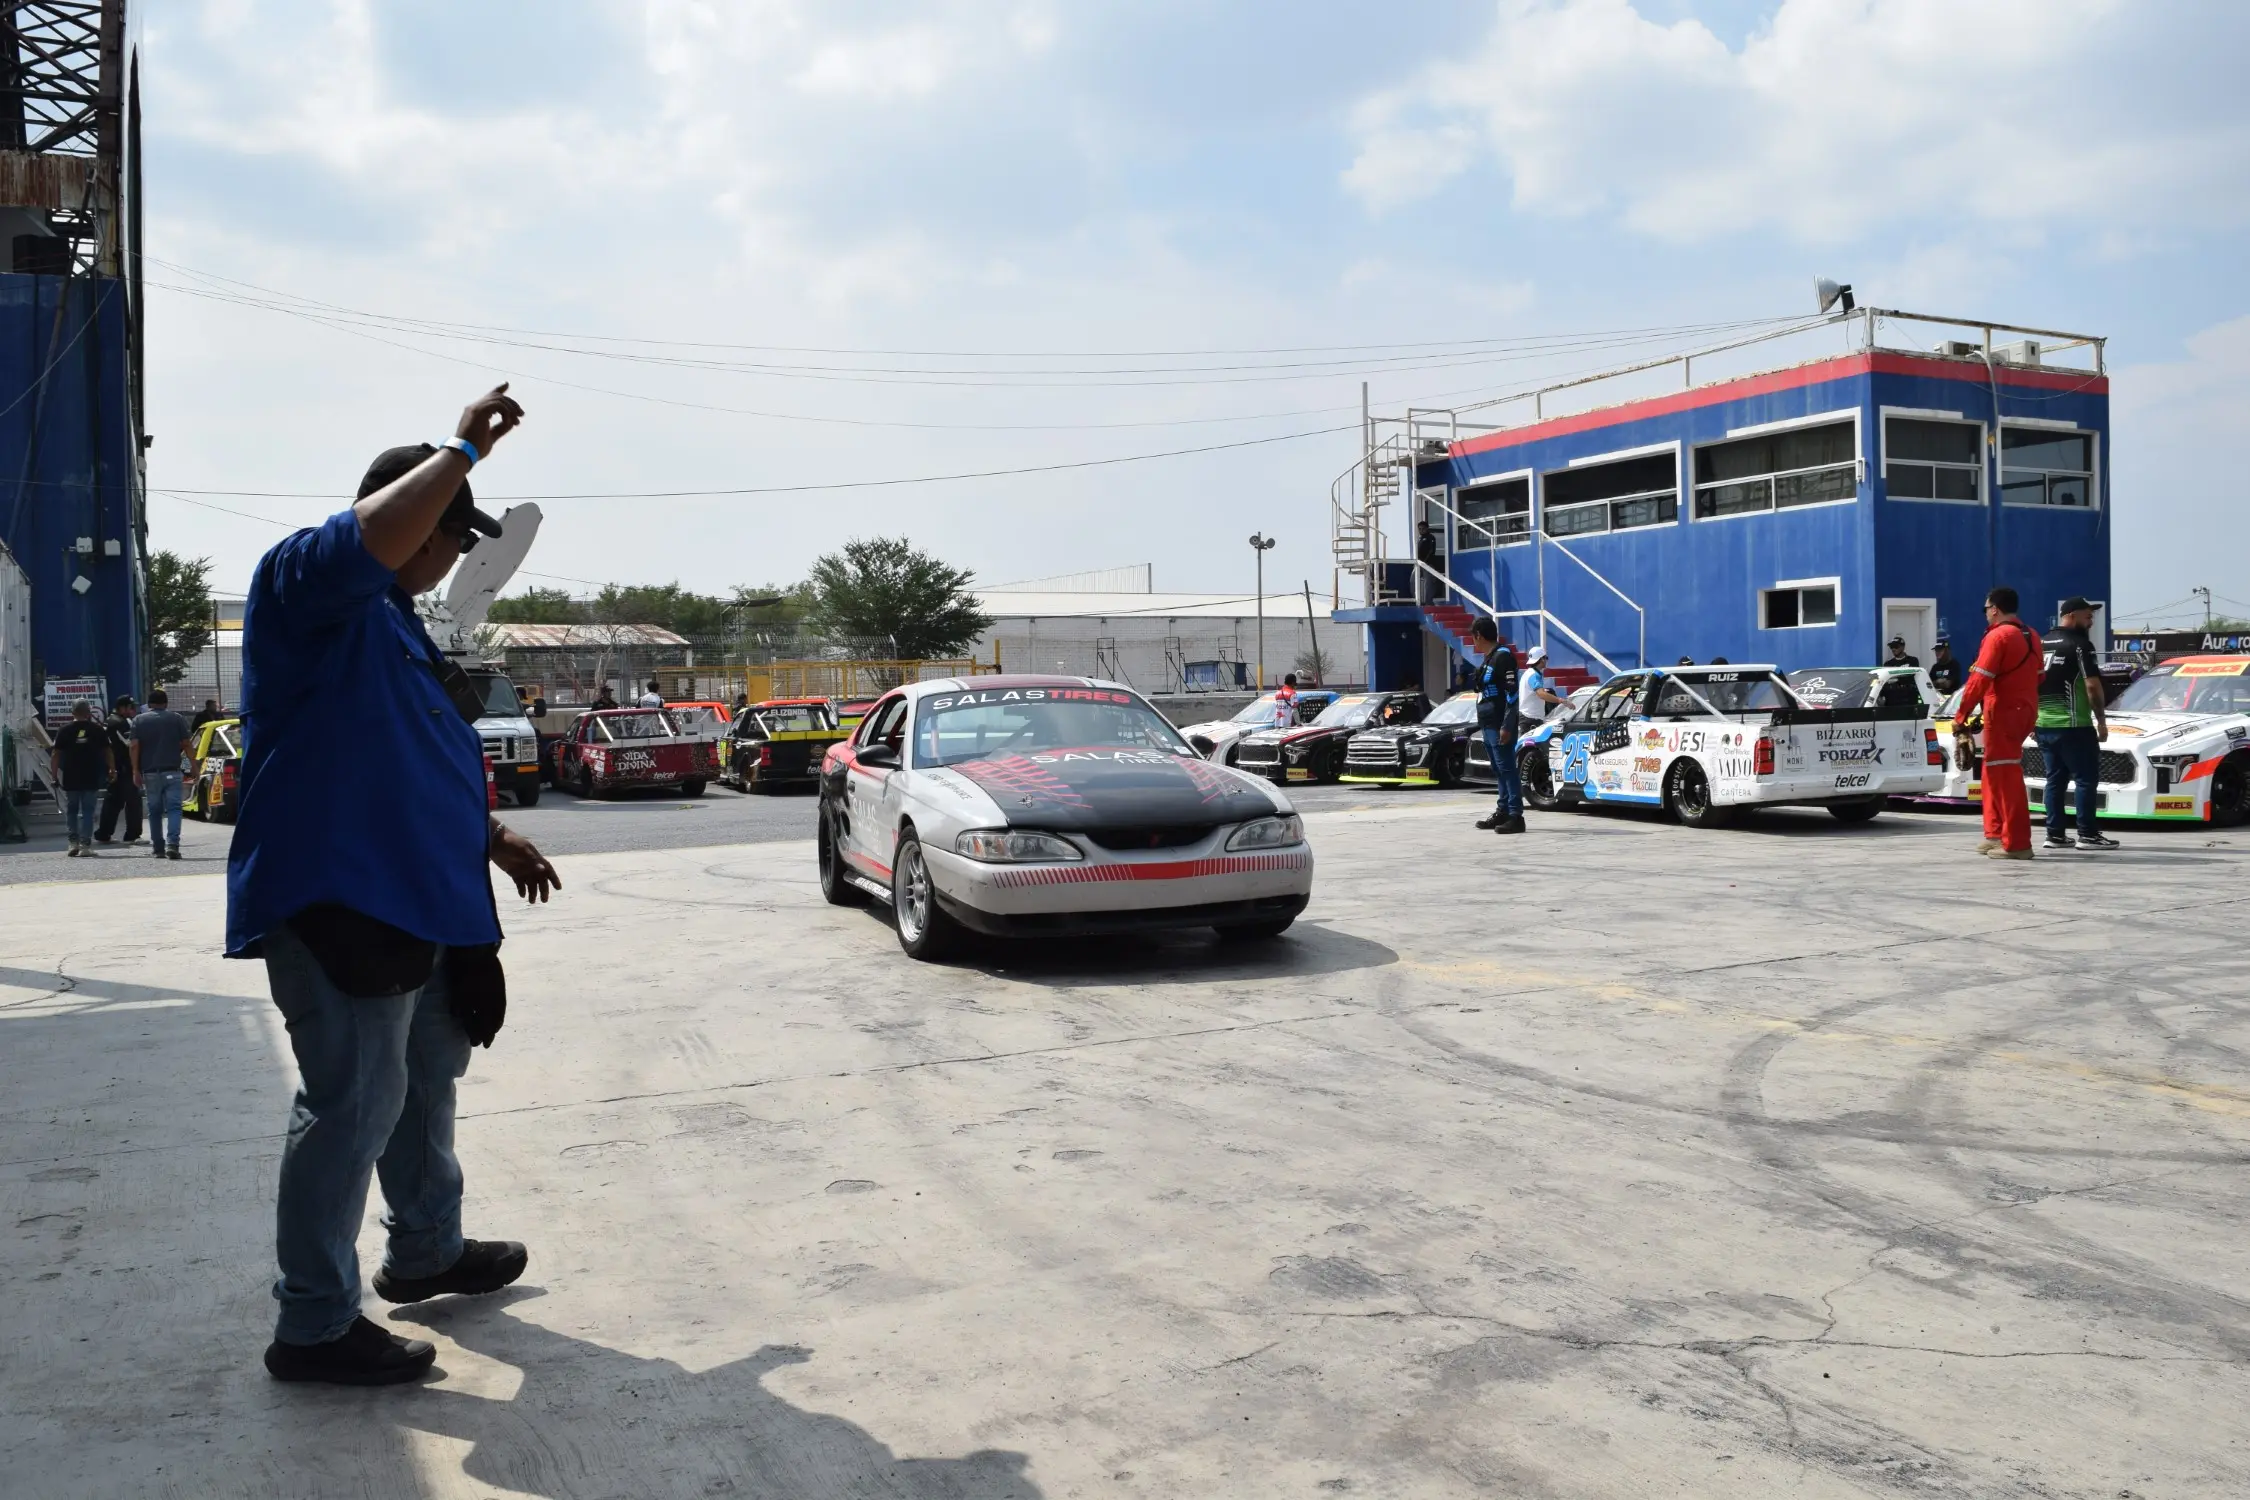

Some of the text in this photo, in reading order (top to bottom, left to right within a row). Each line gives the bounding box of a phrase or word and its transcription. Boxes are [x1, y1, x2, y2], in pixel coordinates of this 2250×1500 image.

[1708, 673, 1739, 682] RUIZ
[770, 708, 808, 716] ELIZONDO
[1816, 728, 1876, 741] BIZZARRO
[622, 751, 649, 761] VIDA
[1031, 751, 1165, 763] SALAS
[1562, 731, 1592, 785] 25
[1818, 748, 1870, 762] FORZA
[617, 759, 657, 771] DIVINA
[1118, 757, 1176, 765] TIRES
[806, 766, 821, 774] tel
[1719, 758, 1752, 777] VALVO
[653, 771, 677, 780] telcel
[1834, 772, 1871, 788] telcel
[1720, 788, 1752, 797] CANTERA
